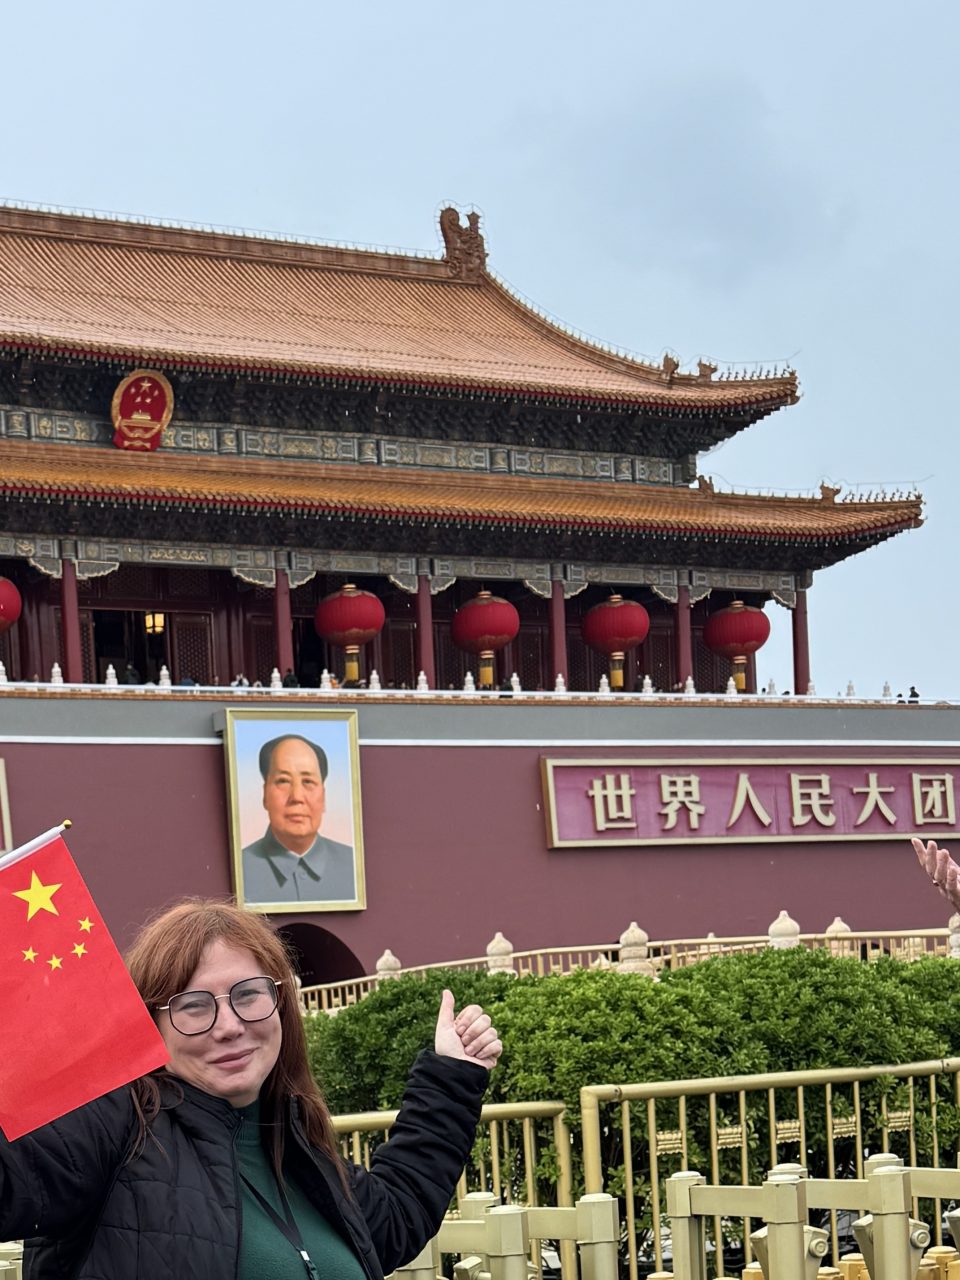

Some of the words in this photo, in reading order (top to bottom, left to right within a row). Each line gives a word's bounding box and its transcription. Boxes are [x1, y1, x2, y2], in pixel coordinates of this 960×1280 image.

[587, 772, 957, 832] 世界人民大团
